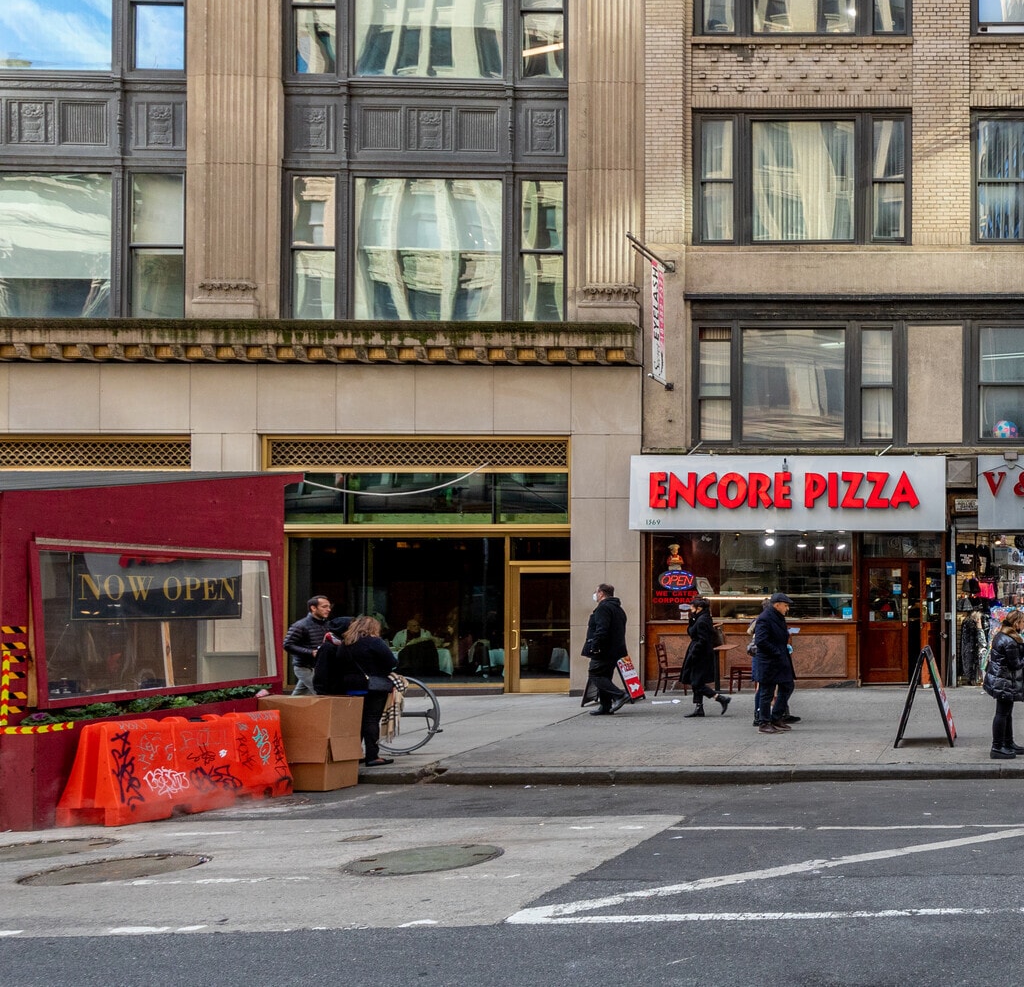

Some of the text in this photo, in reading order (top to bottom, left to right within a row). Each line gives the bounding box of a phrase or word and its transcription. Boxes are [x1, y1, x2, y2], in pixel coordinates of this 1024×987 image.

[649, 470, 921, 509] ENCORE PIZZA
[983, 471, 1007, 498] V
[78, 573, 238, 602] NOW OPEN
[660, 576, 694, 586] OPEN
